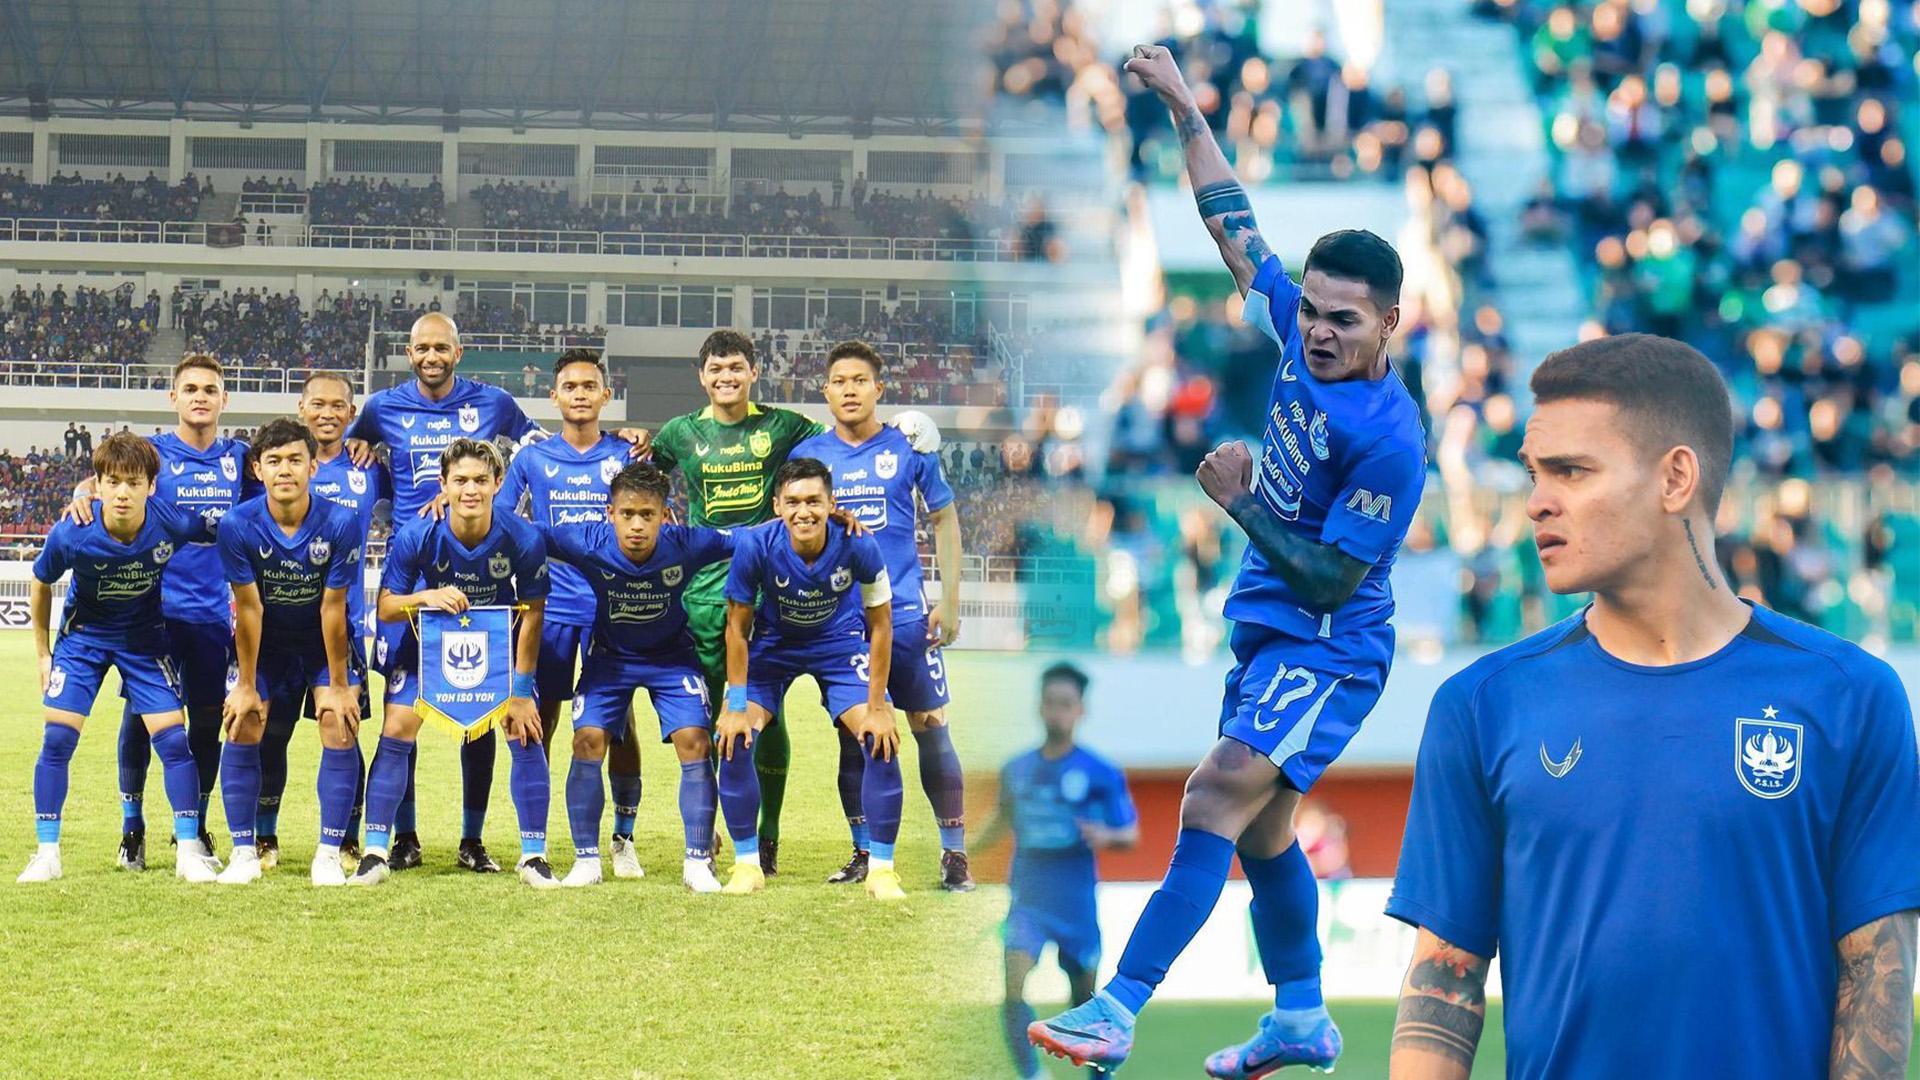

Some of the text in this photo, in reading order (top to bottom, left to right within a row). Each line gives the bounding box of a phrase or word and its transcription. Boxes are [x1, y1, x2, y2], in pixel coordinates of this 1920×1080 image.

[1270, 401, 1311, 476] KukuBima
[702, 461, 763, 473] KukuBima
[177, 486, 232, 497] KukuBima
[549, 489, 608, 502] KukuBima
[832, 485, 885, 497] ukuBima
[1257, 662, 1318, 711] 17
[456, 692, 474, 703] ISO
